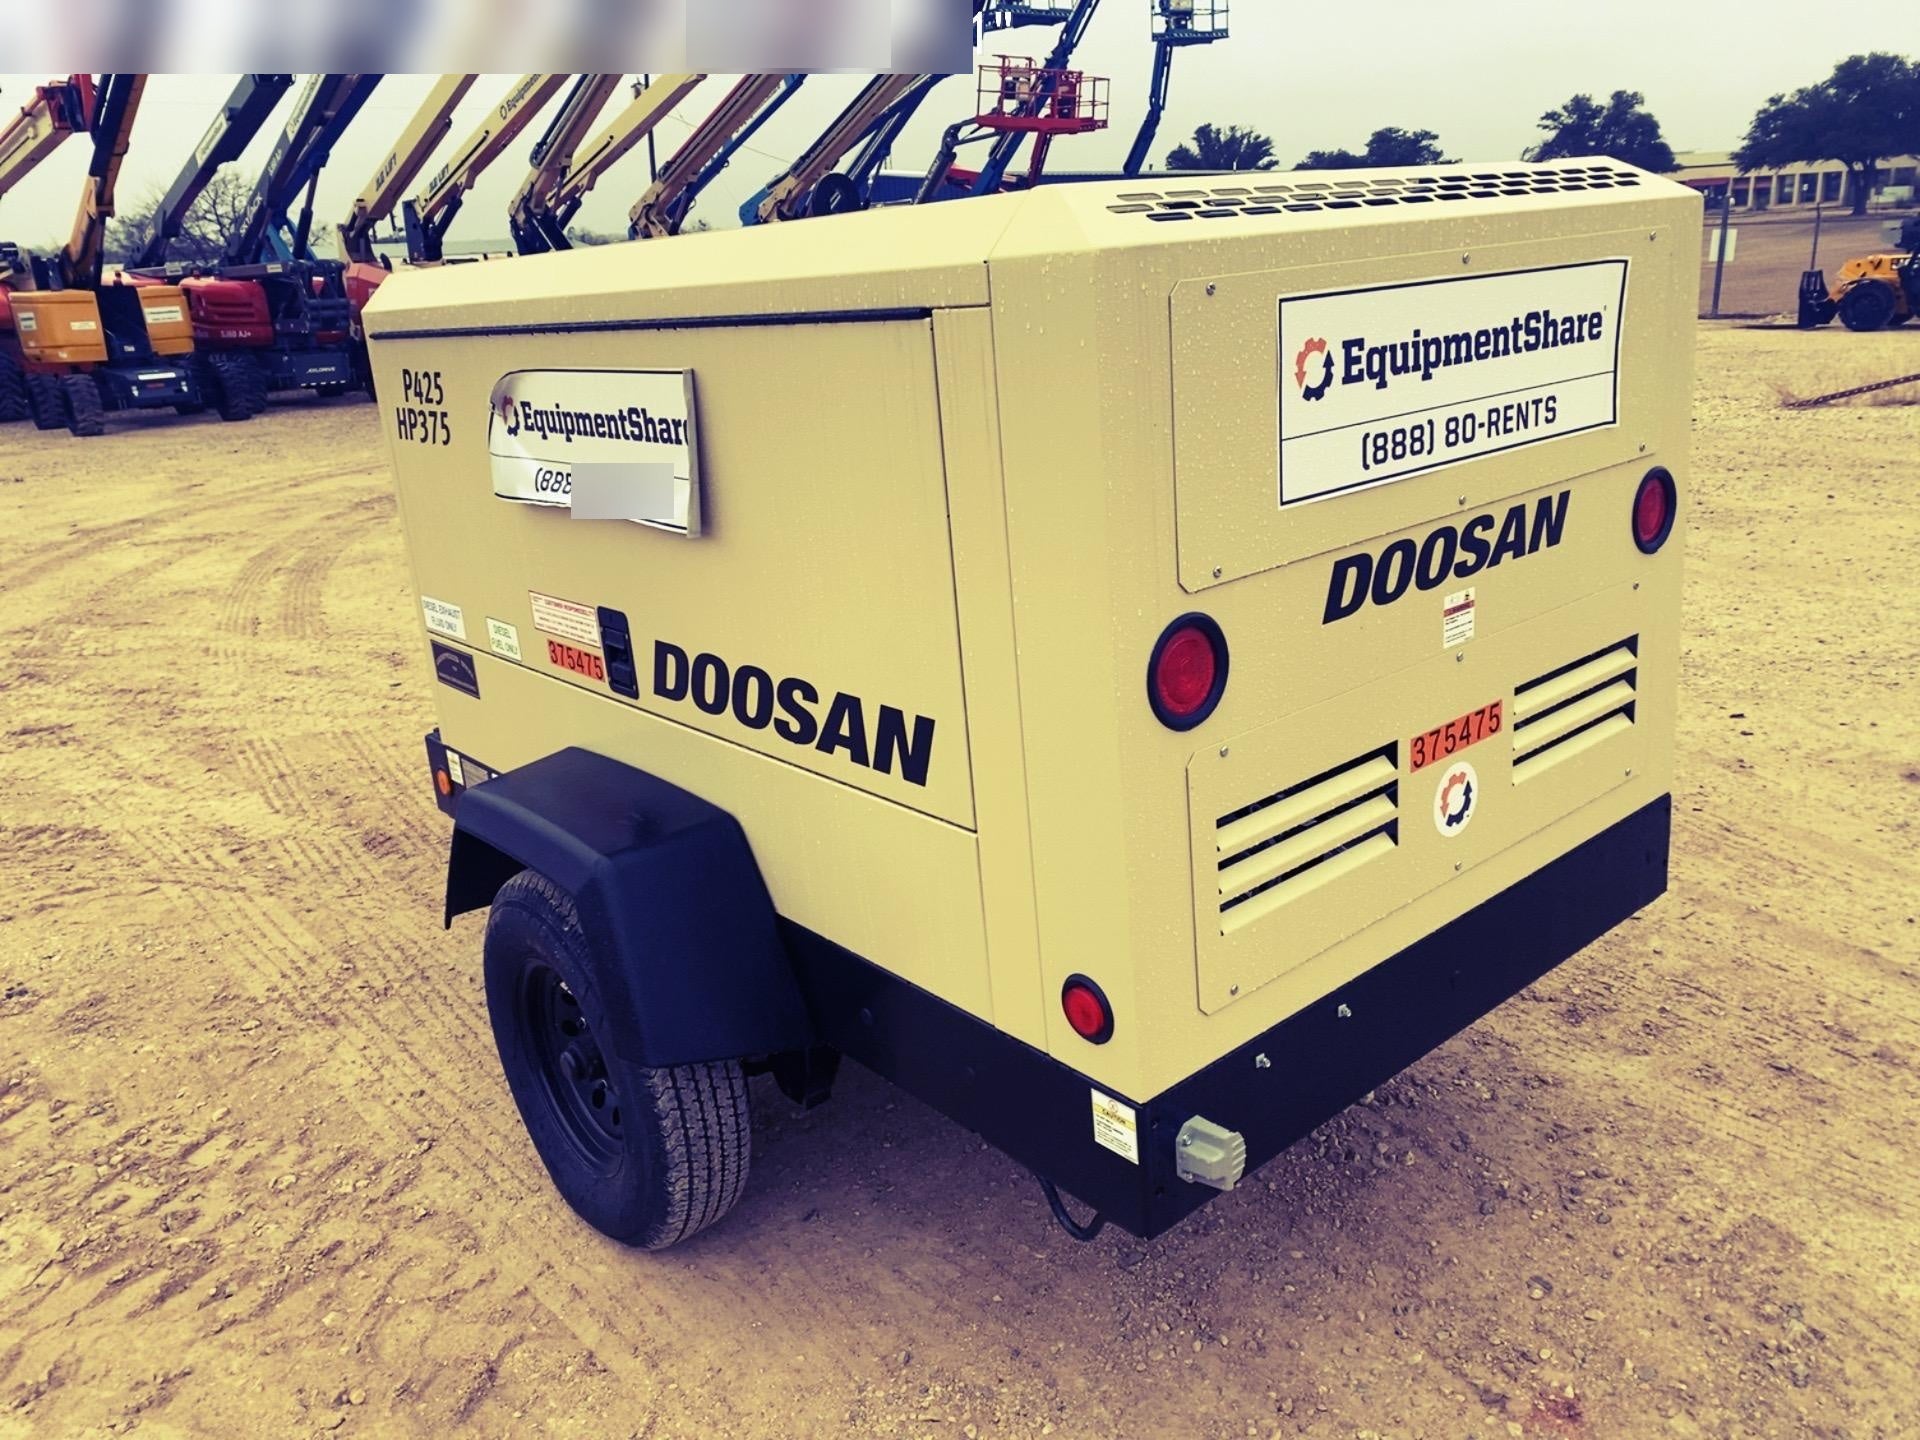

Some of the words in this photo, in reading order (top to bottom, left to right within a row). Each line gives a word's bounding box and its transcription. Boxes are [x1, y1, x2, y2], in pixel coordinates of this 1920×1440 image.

[1341, 309, 1603, 391] EquipmentShare
[402, 368, 444, 405] P425
[396, 407, 451, 446] HP375
[1361, 419, 1435, 471] (888)
[1444, 395, 1557, 448] 80-RENTS
[1321, 489, 1571, 625] DOOSAN
[548, 640, 604, 680] 375475
[653, 639, 936, 787] DOOSAN
[1412, 701, 1501, 768] 375475
